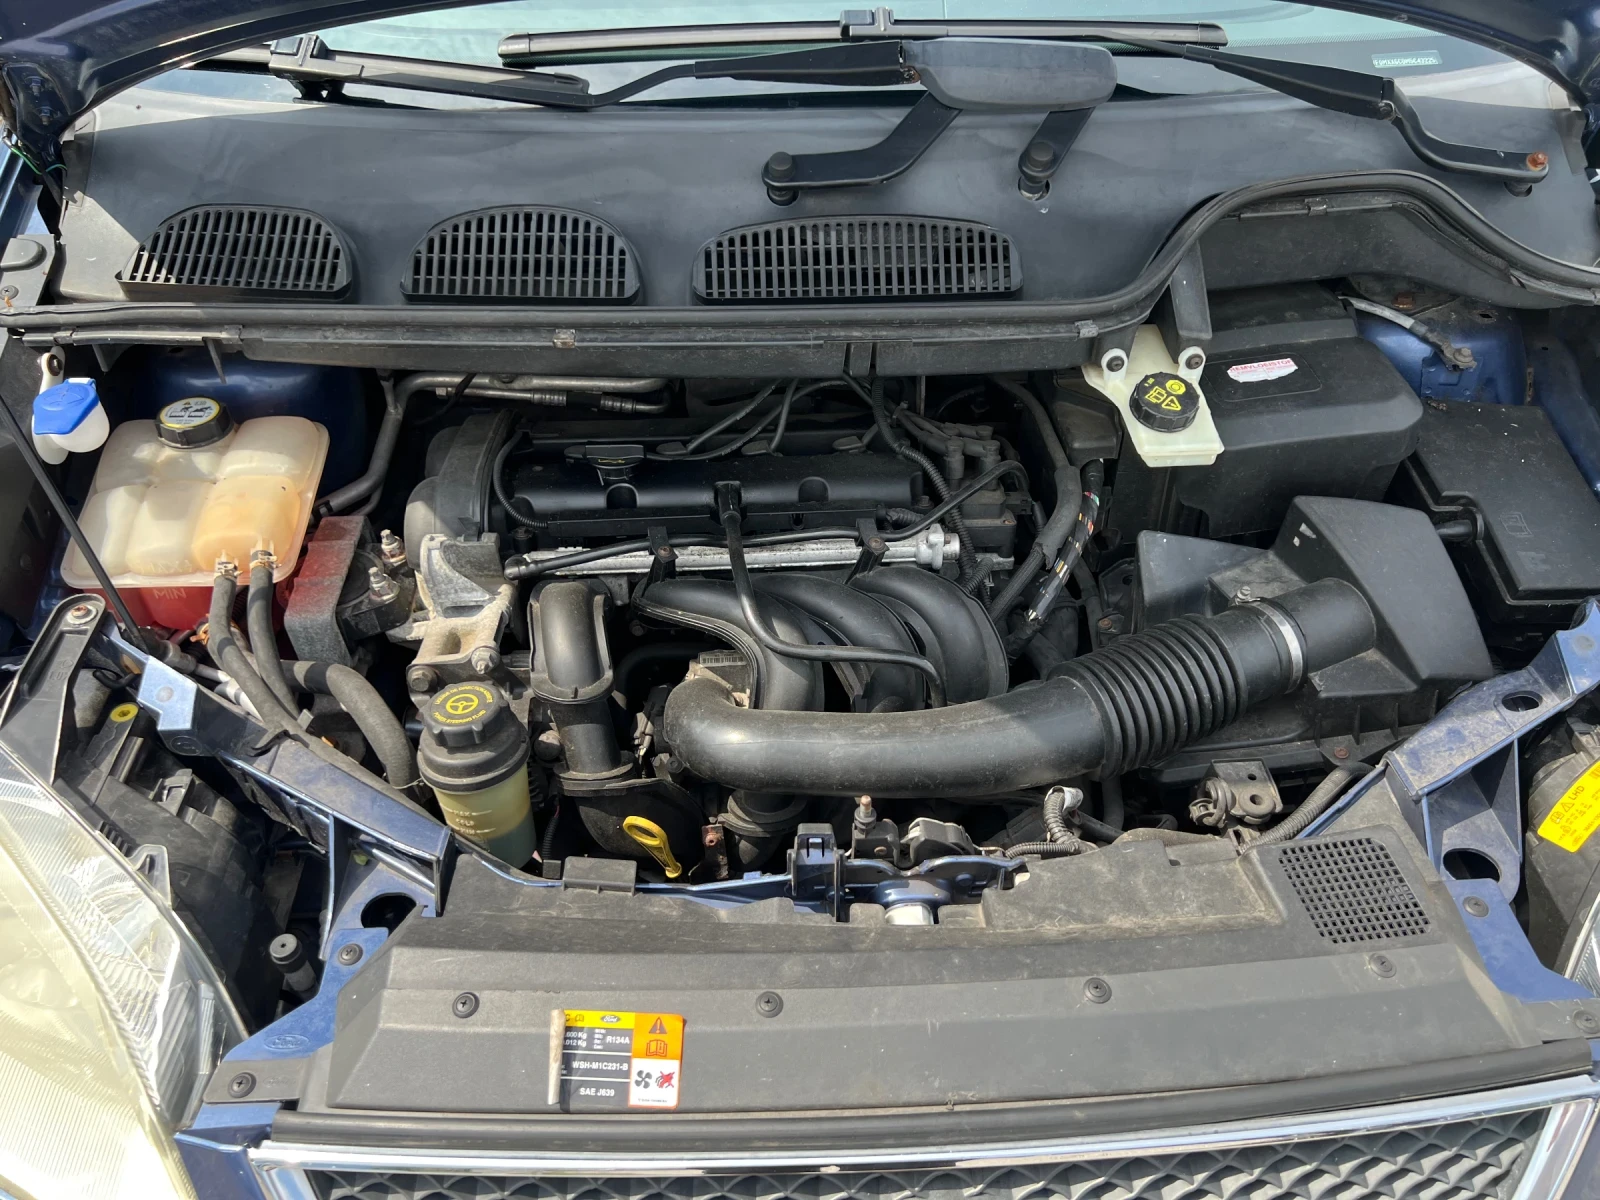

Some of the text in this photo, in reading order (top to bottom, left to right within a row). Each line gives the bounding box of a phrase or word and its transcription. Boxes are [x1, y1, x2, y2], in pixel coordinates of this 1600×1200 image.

[152, 587, 187, 600] MIN
[1568, 785, 1585, 801] LHD
[578, 1031, 588, 1040] Kg
[606, 1035, 630, 1045] R134A
[577, 1039, 587, 1048] Kg
[572, 1060, 629, 1071] WSH-M1C231-B
[580, 1087, 615, 1097] SAE J639
